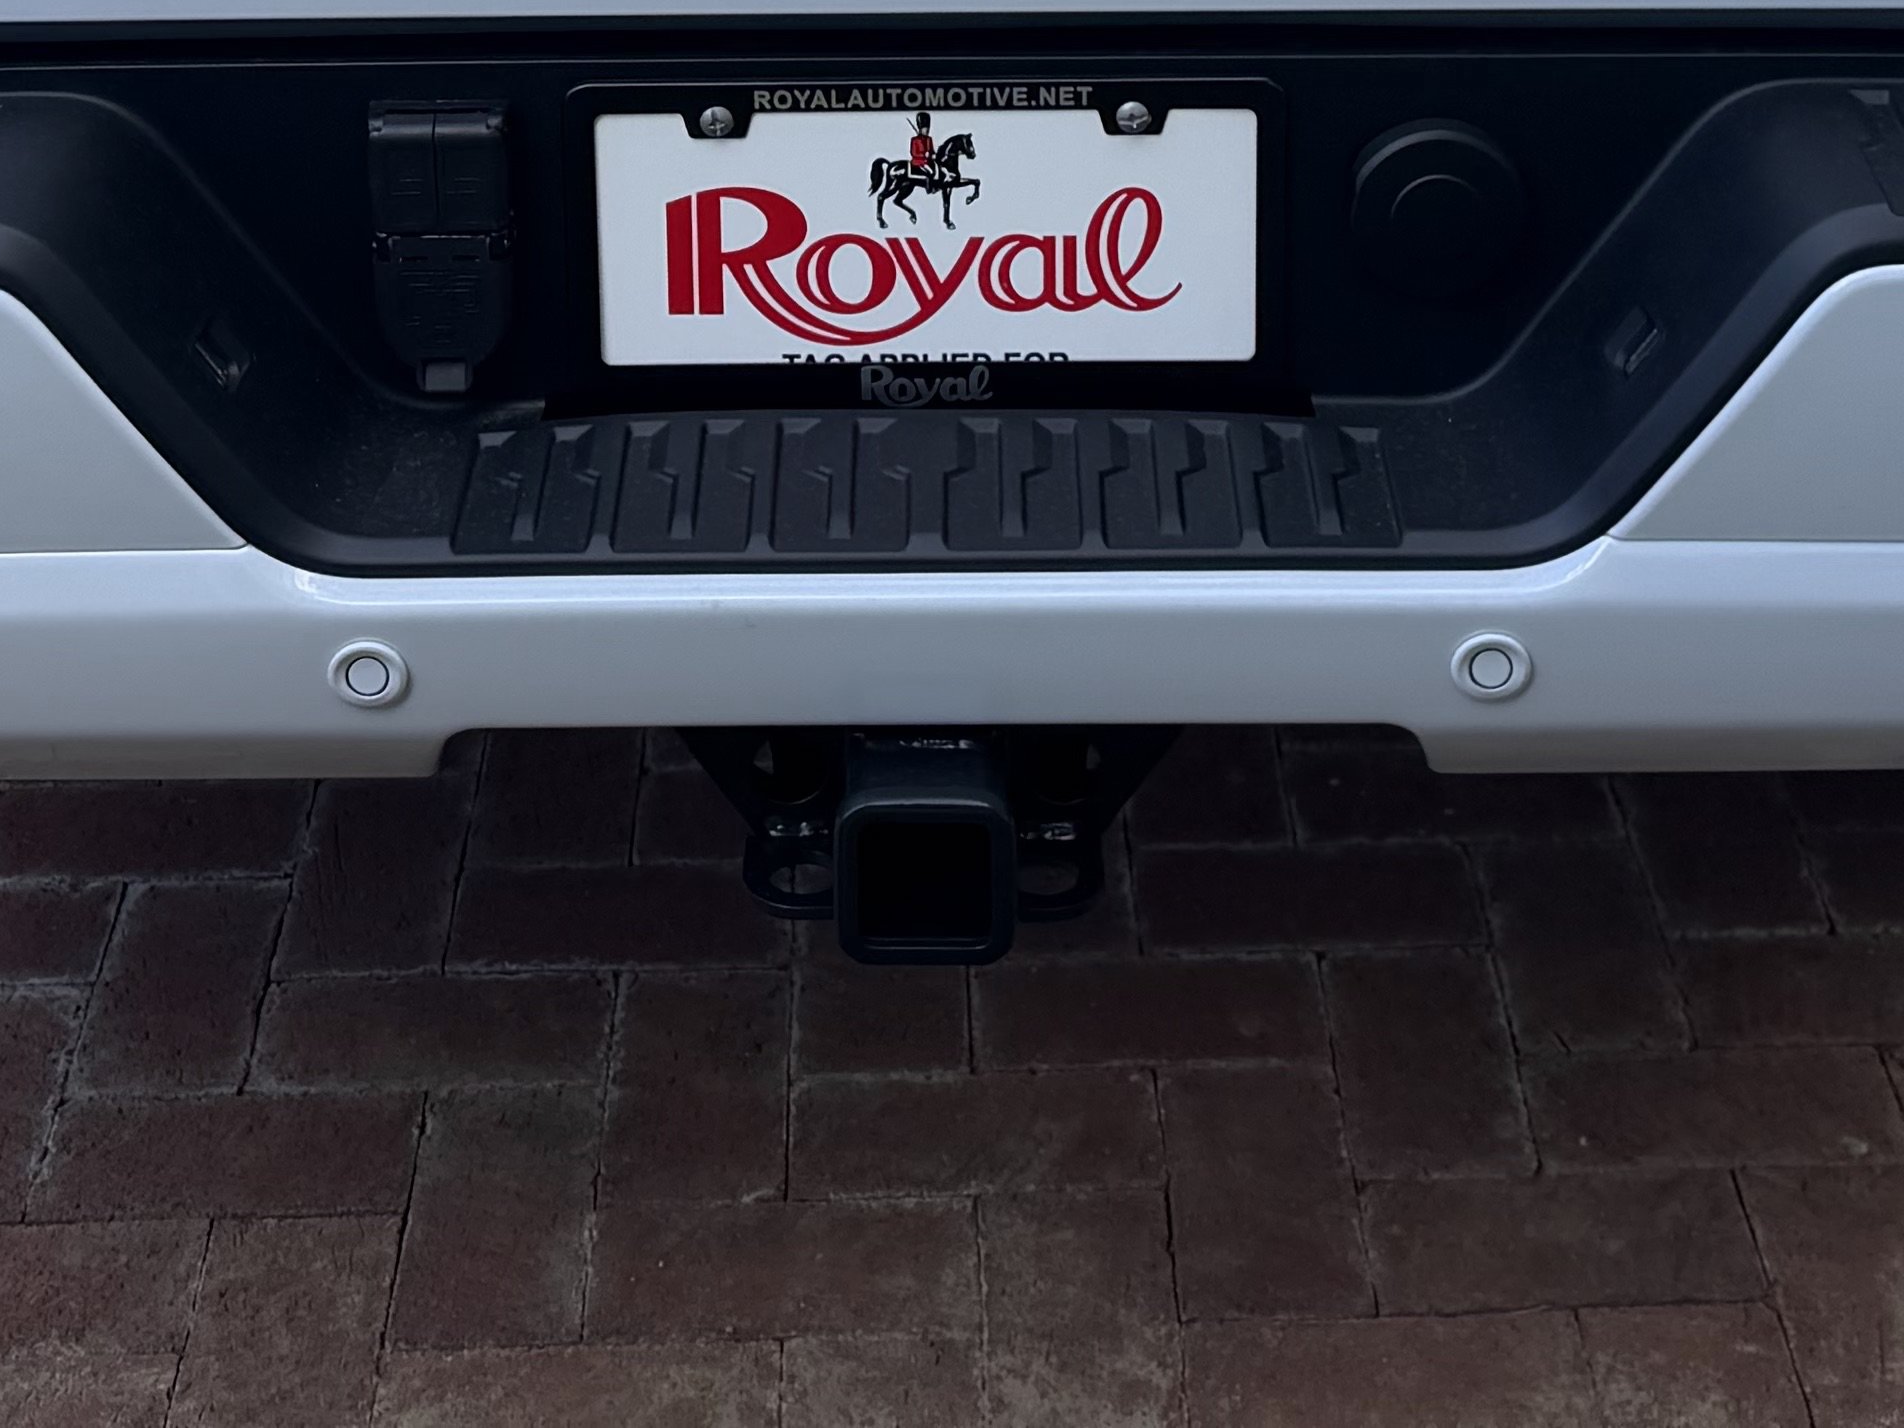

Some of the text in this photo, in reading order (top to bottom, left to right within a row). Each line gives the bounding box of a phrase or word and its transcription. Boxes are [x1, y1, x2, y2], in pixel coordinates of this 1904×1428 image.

[754, 86, 1093, 110] ROYALAUTOMOTIVE.NET
[665, 186, 1183, 346] Royal
[860, 365, 994, 407] Royal
